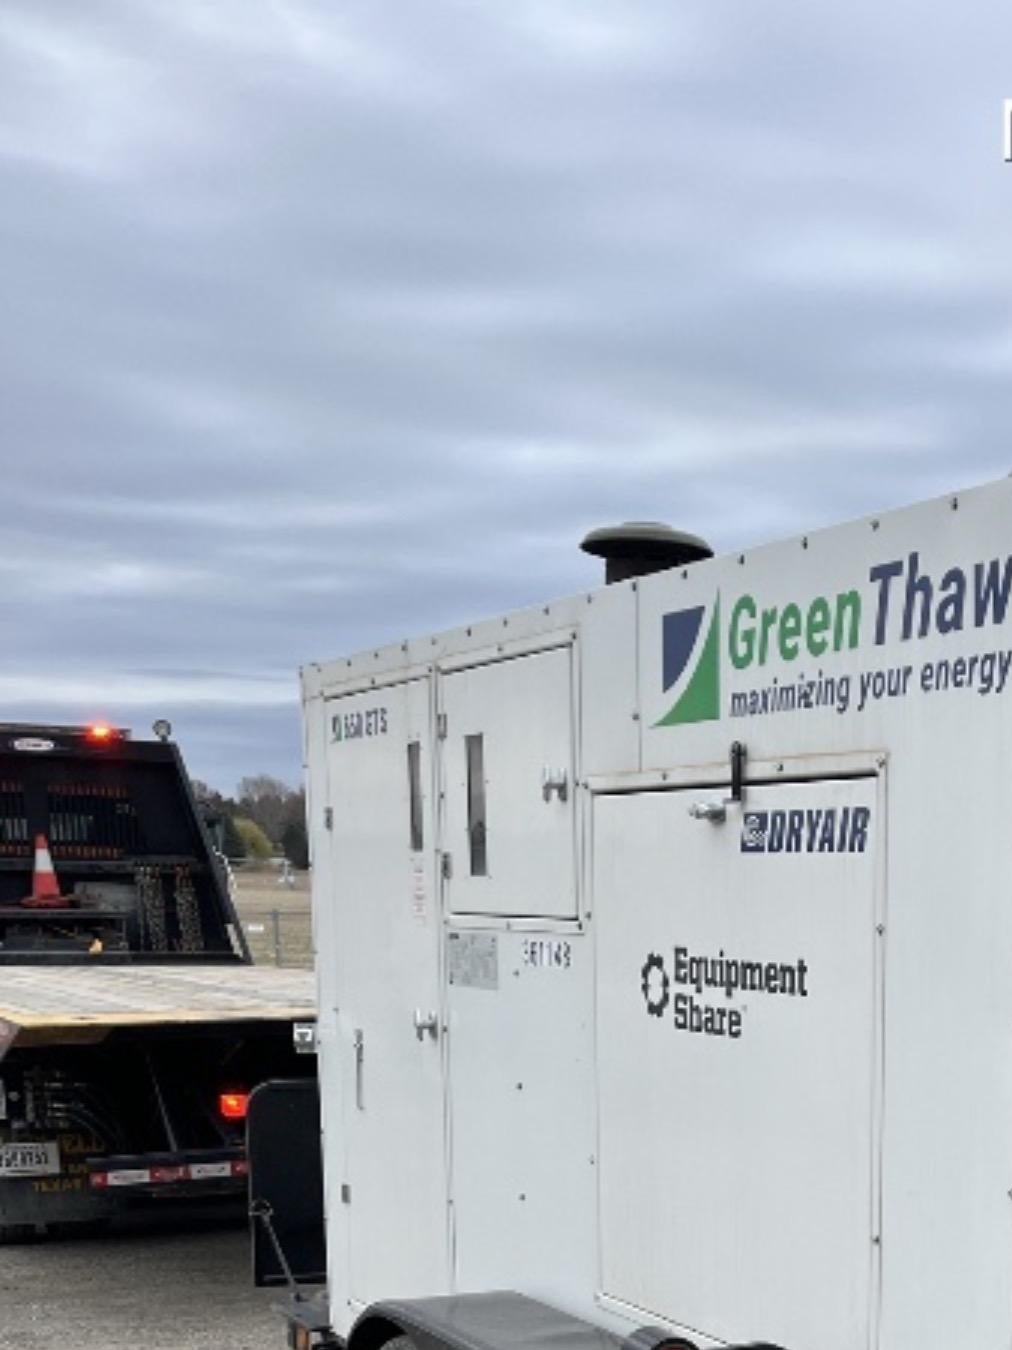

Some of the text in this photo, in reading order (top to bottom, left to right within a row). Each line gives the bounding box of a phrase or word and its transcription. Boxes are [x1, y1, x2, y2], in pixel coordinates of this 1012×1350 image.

[729, 668, 852, 718] maximizing
[856, 663, 914, 712] your
[767, 806, 871, 854] DRYAIR
[674, 946, 808, 999] Equipment
[674, 993, 742, 1039] Share
